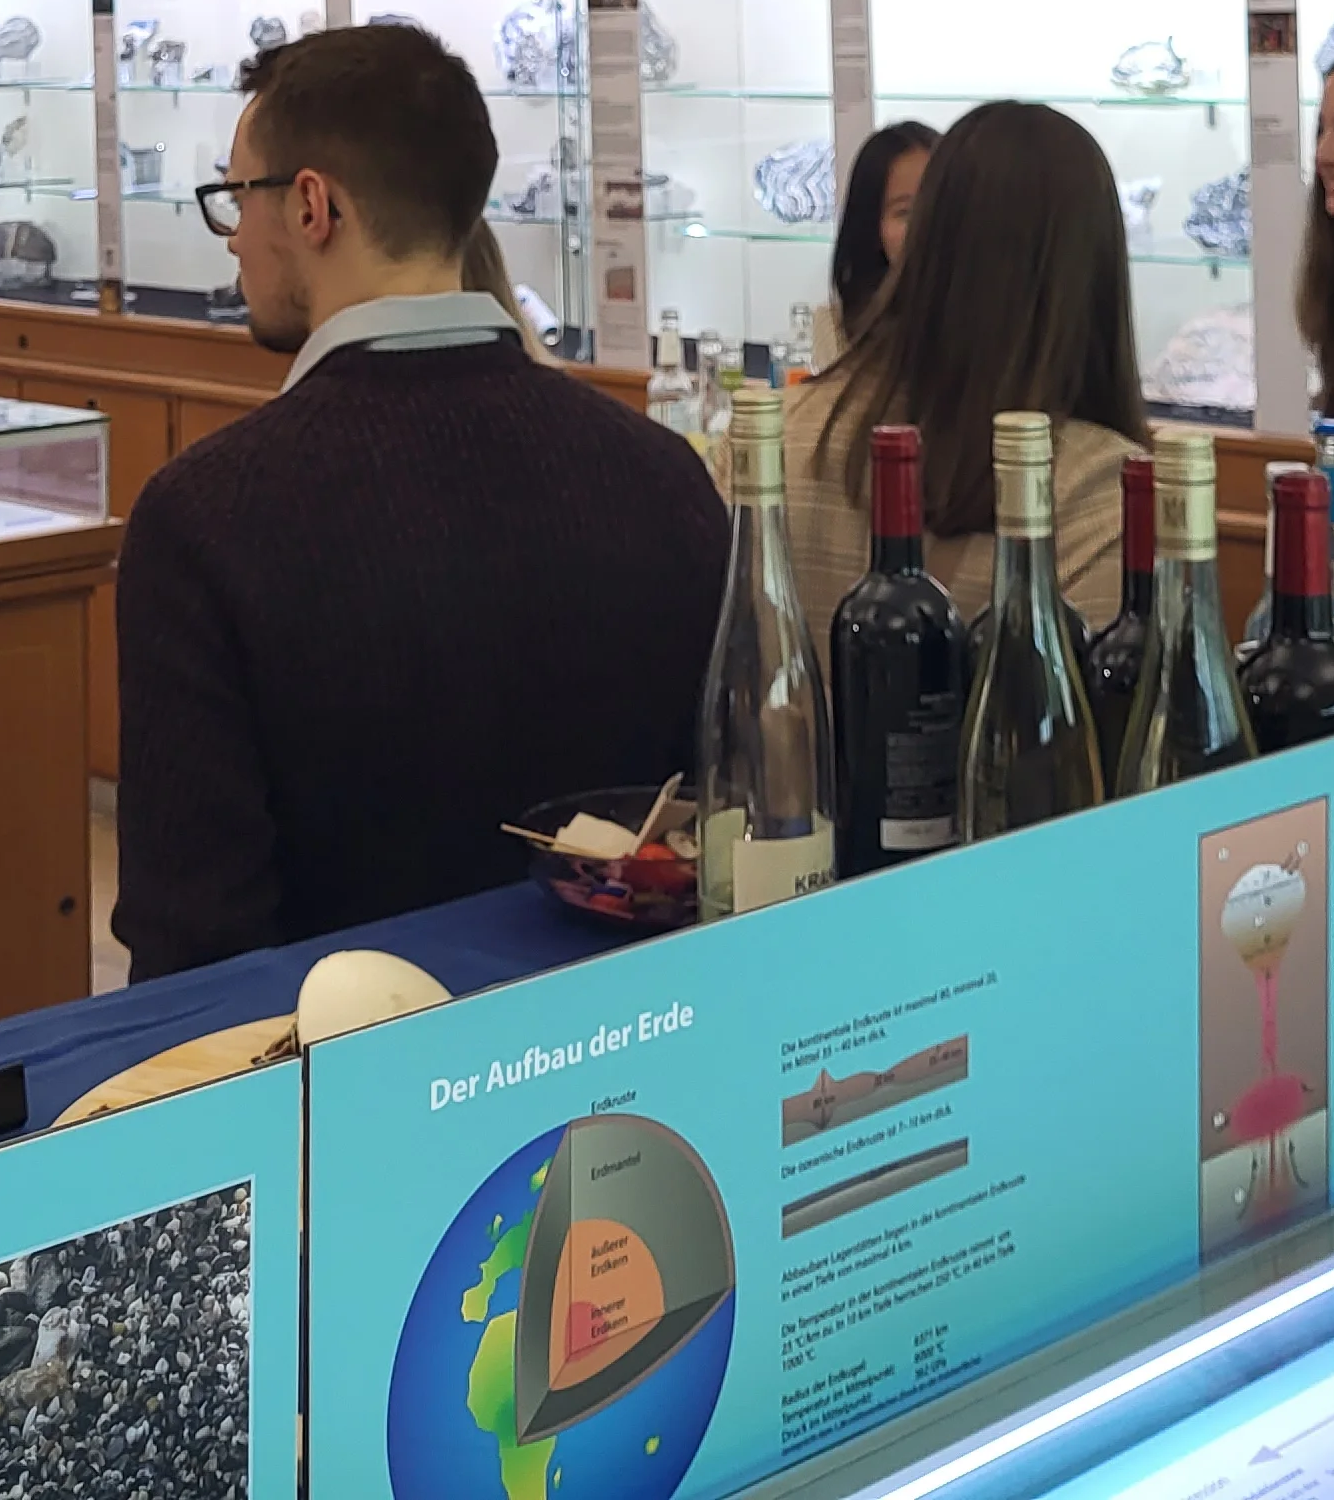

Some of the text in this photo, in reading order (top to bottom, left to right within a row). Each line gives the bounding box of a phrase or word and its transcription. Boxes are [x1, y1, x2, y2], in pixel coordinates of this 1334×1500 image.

[430, 1001, 694, 1111] Der Aufbau der Erde
[590, 1151, 641, 1182] Erdmantel
[590, 1255, 628, 1279] Erdkern
[590, 1315, 628, 1339] Erdkern
